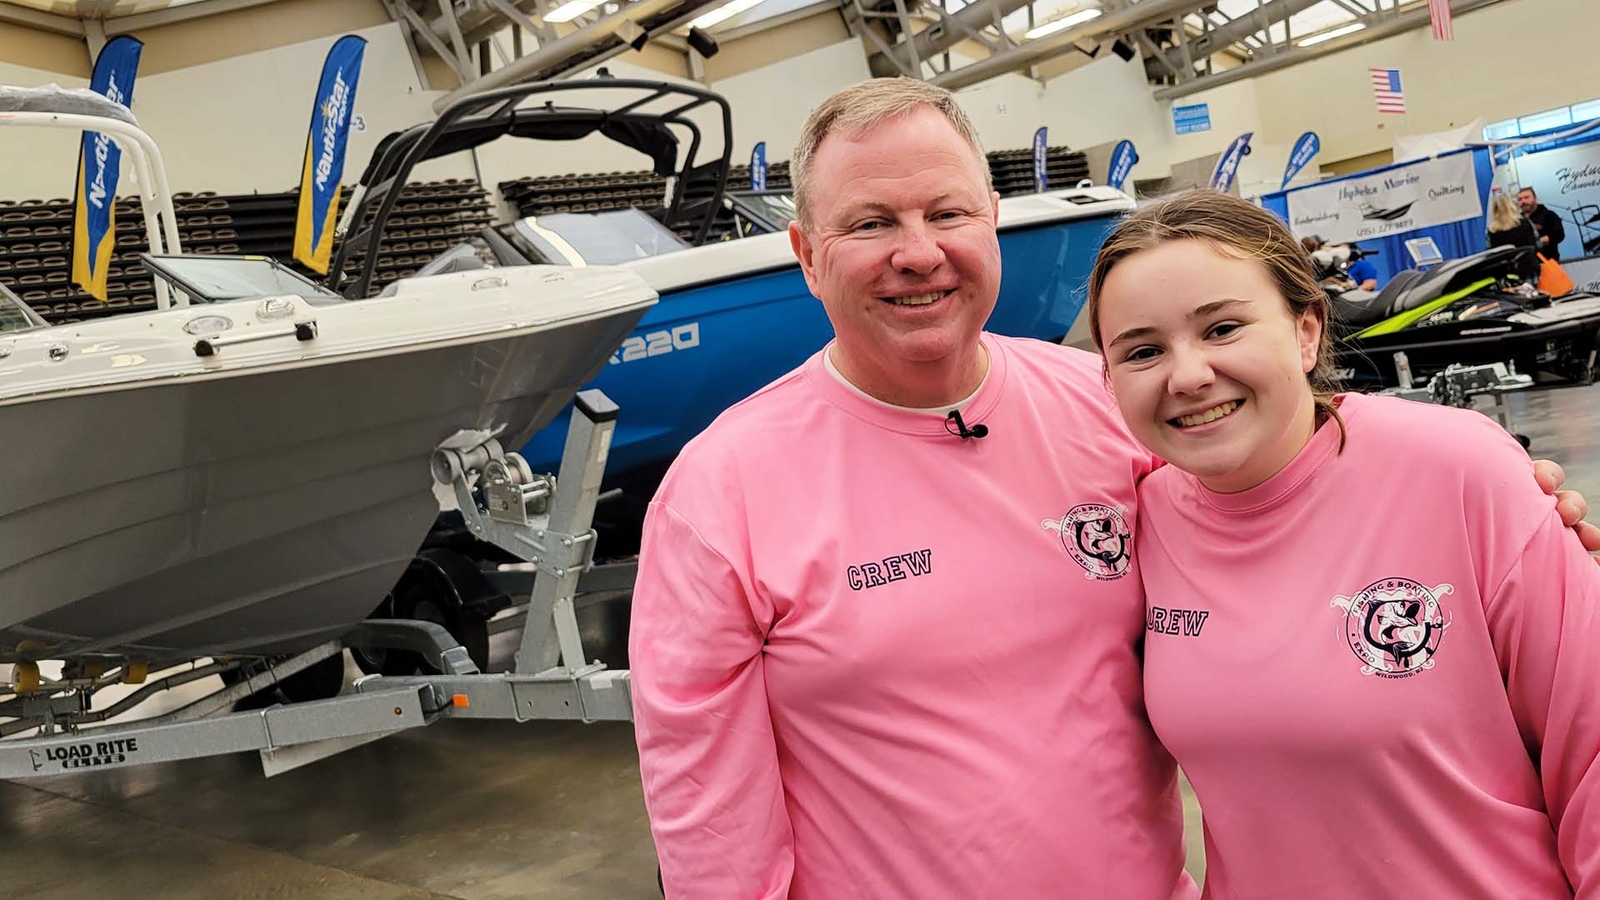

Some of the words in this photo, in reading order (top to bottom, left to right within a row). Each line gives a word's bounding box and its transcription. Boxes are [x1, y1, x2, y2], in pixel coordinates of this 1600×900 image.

[315, 69, 346, 192] NauticStar
[847, 548, 932, 590] CREW
[1074, 553, 1094, 570] EXPO
[1353, 583, 1384, 613] FISHING
[1397, 581, 1435, 608] BOATING
[1353, 641, 1376, 663] EXPO
[45, 744, 93, 761] LOAD
[96, 738, 138, 756] RITE
